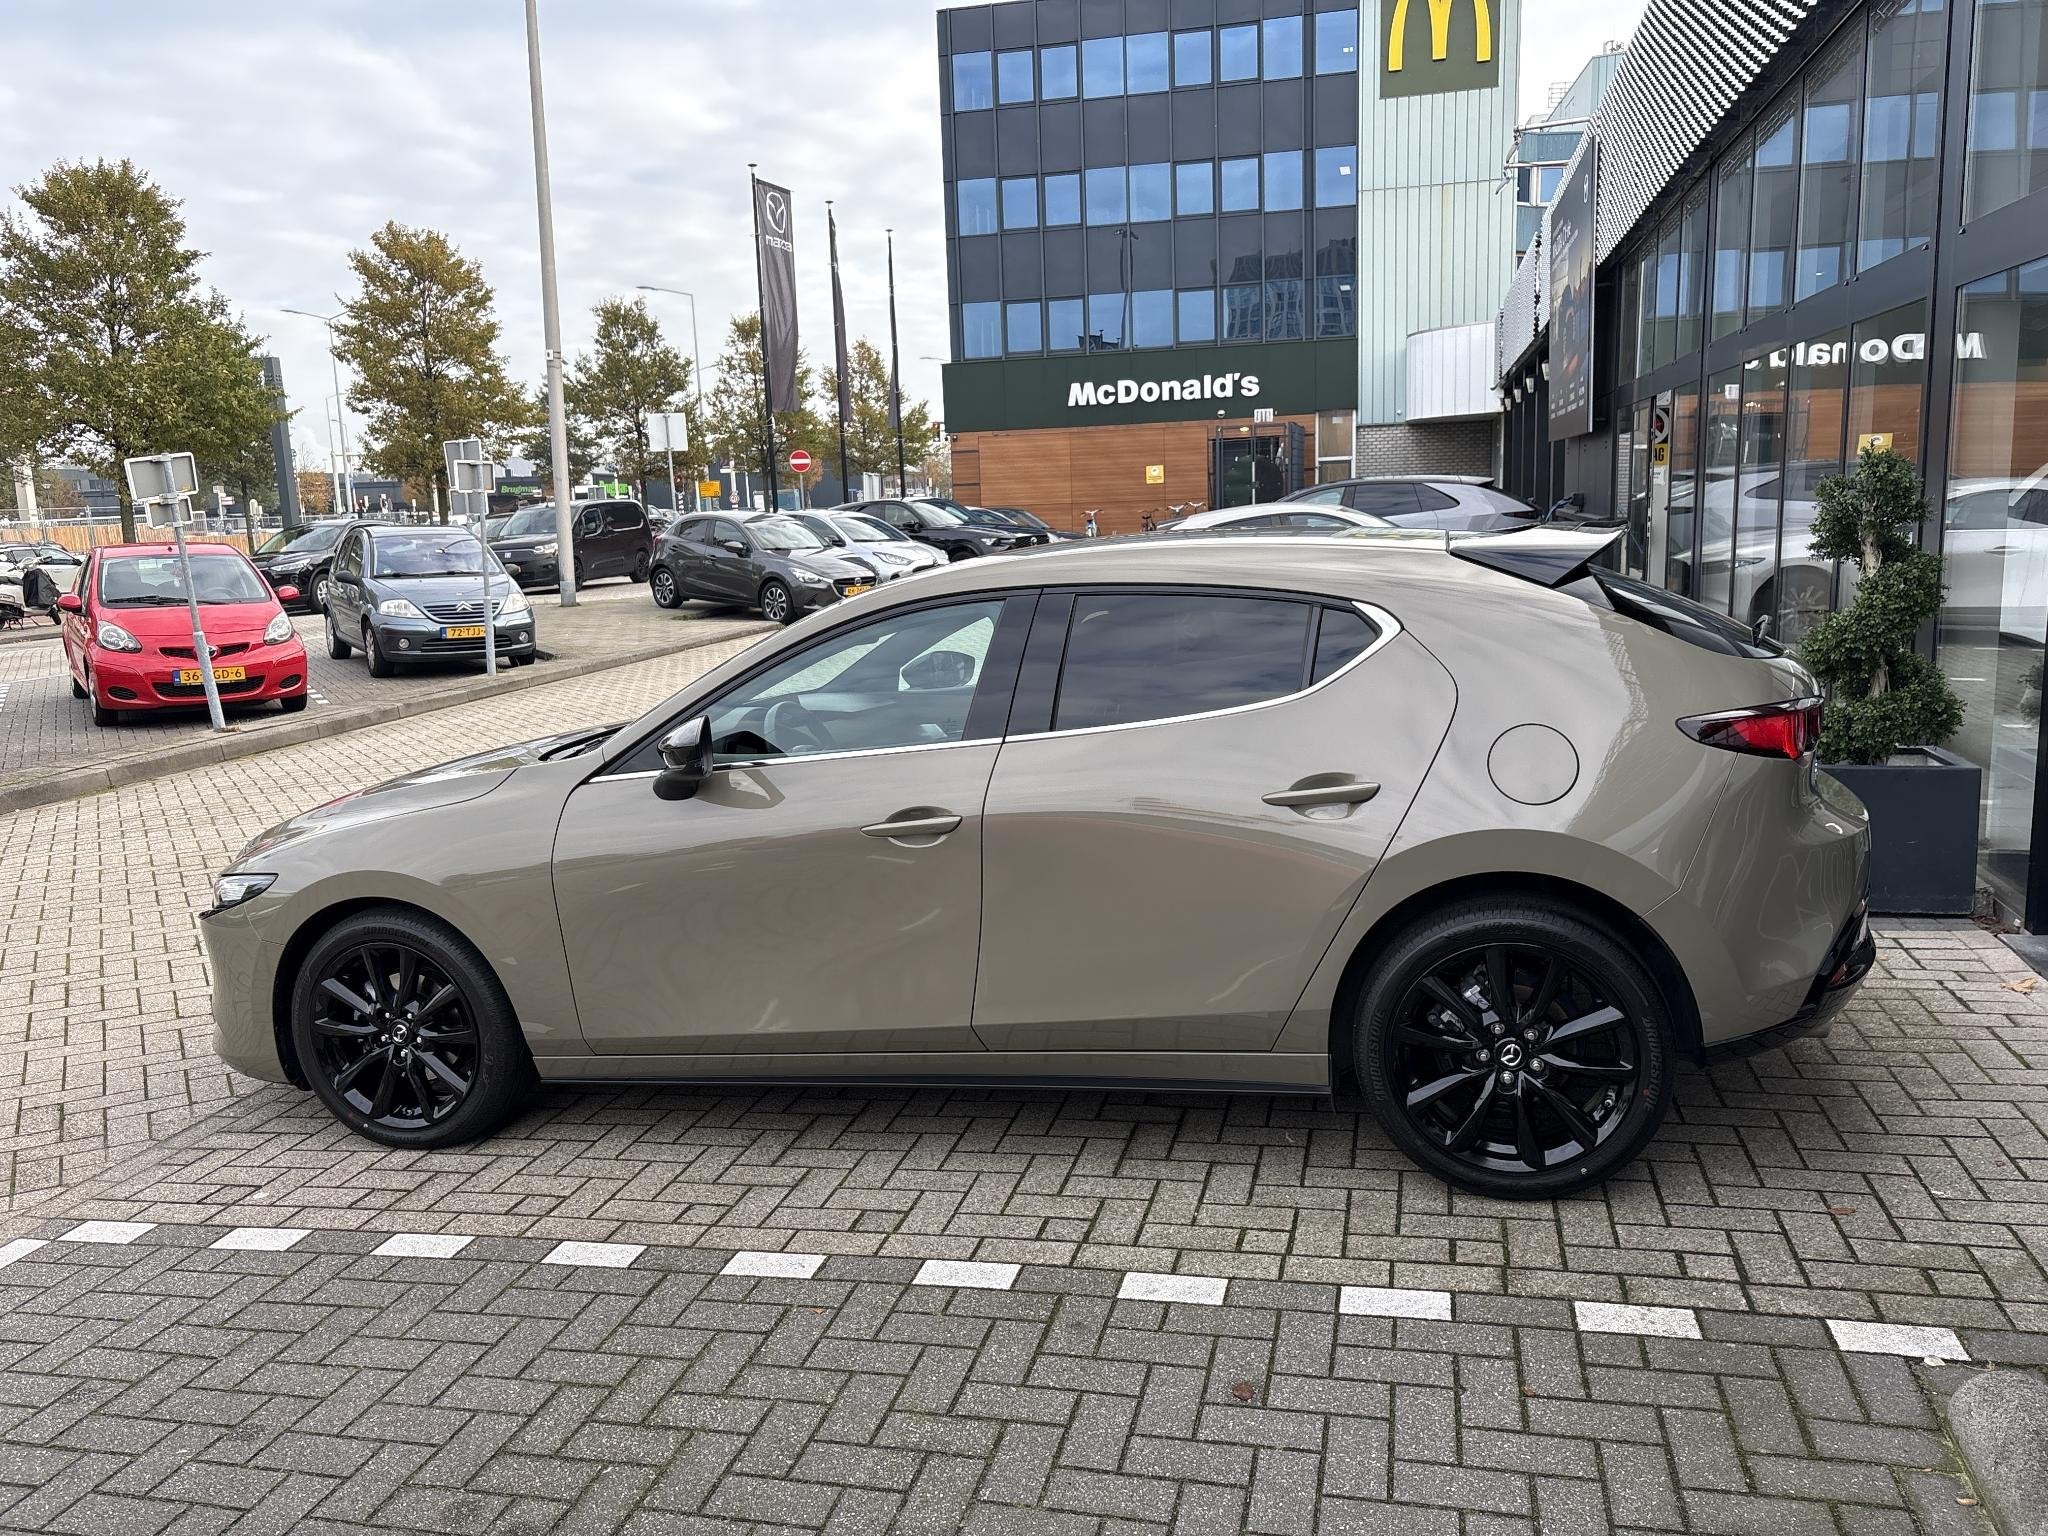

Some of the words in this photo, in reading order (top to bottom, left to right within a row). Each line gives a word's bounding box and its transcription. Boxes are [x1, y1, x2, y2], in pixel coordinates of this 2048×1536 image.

[1068, 372, 1261, 416] McDonald's
[450, 627, 487, 638] 72-TJJ-
[183, 667, 243, 682] 36-GD-6
